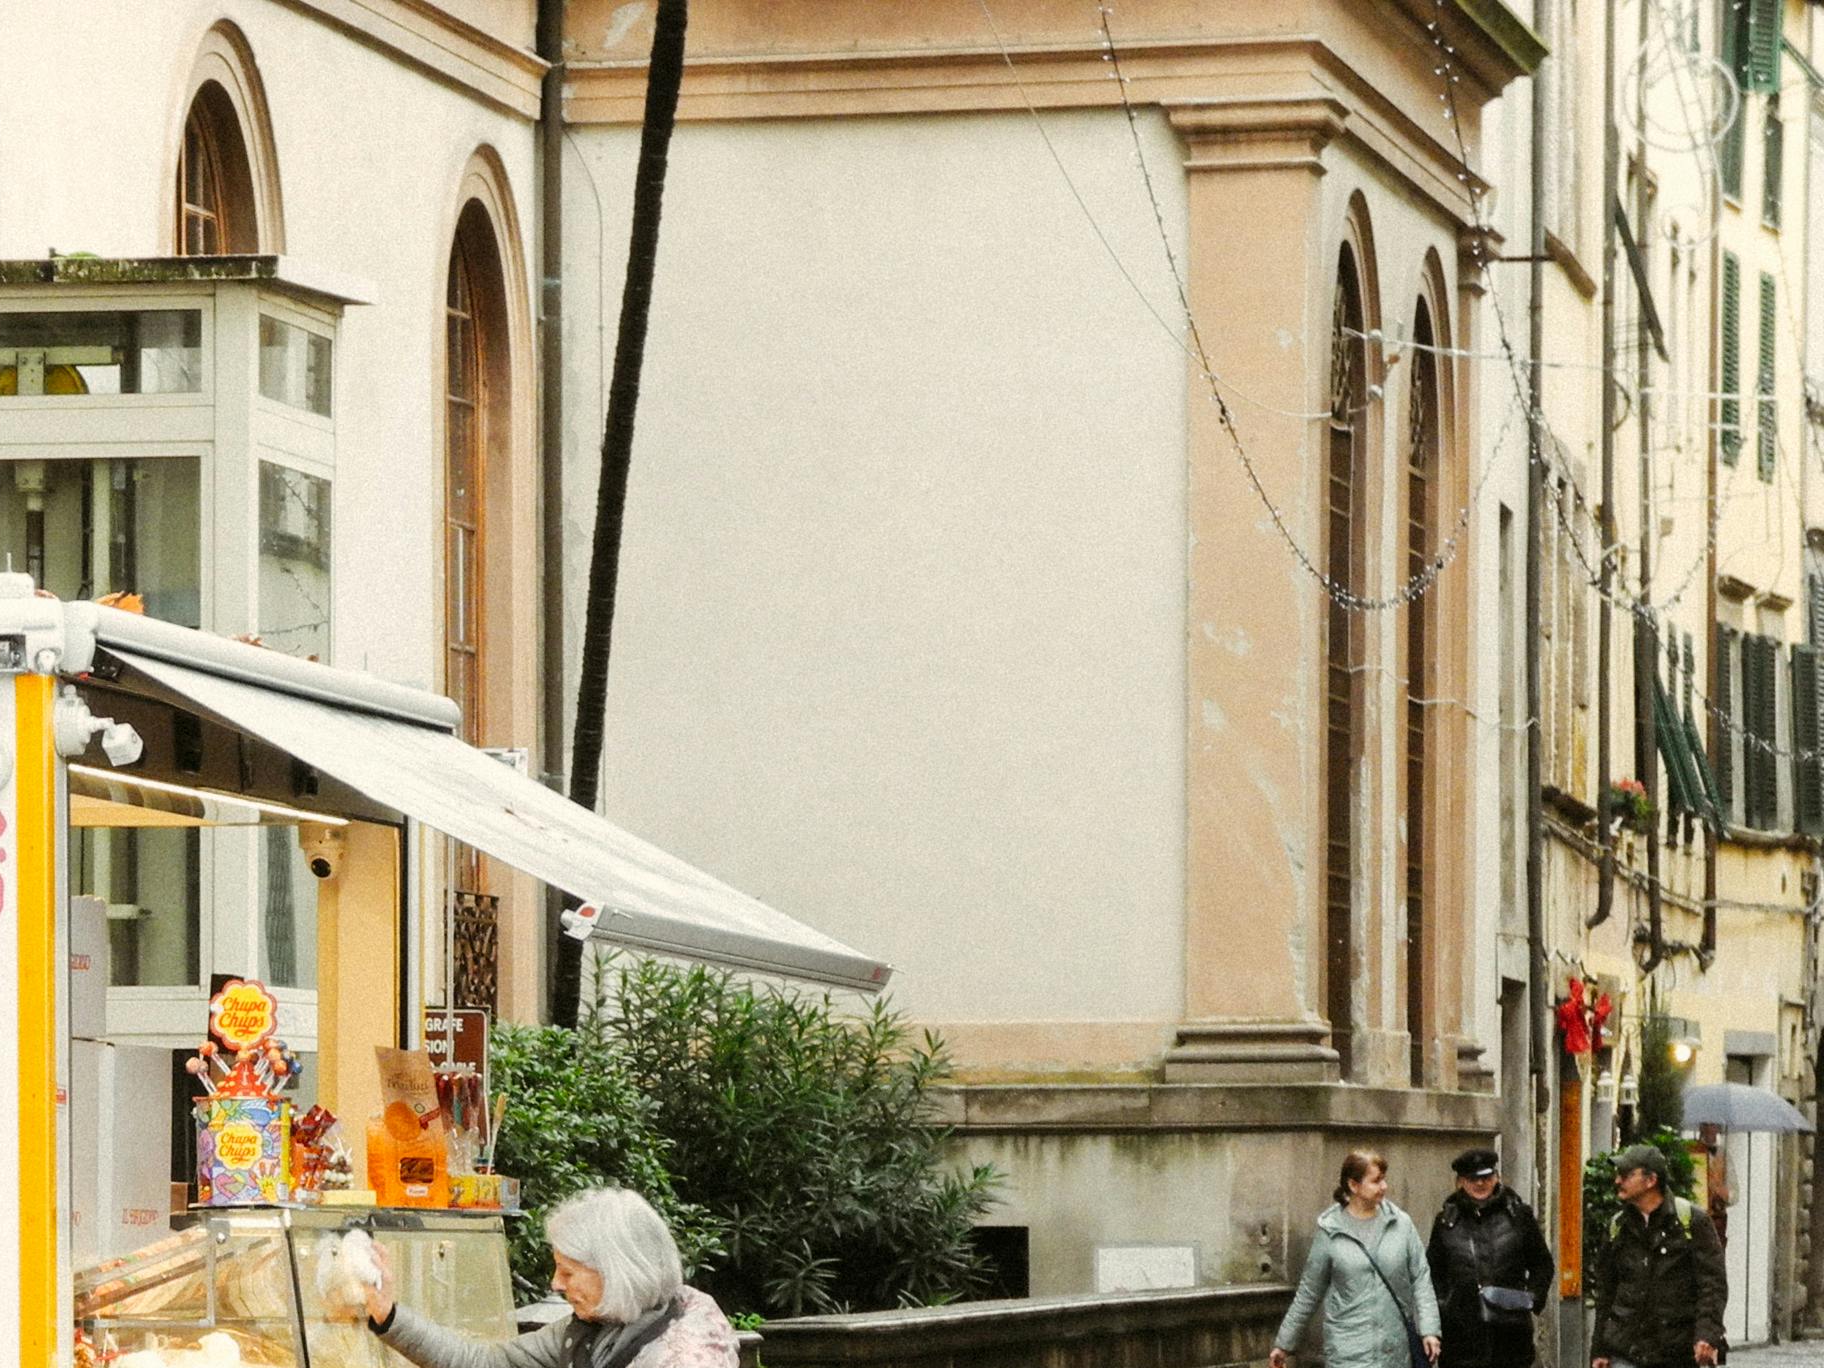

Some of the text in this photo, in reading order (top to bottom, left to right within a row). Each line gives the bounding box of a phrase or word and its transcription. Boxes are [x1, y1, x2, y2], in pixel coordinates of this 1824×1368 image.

[222, 997, 267, 1016] Chupa
[219, 1012, 265, 1037] Chups
[221, 1132, 257, 1146] Chupa
[219, 1144, 256, 1164] Chups
